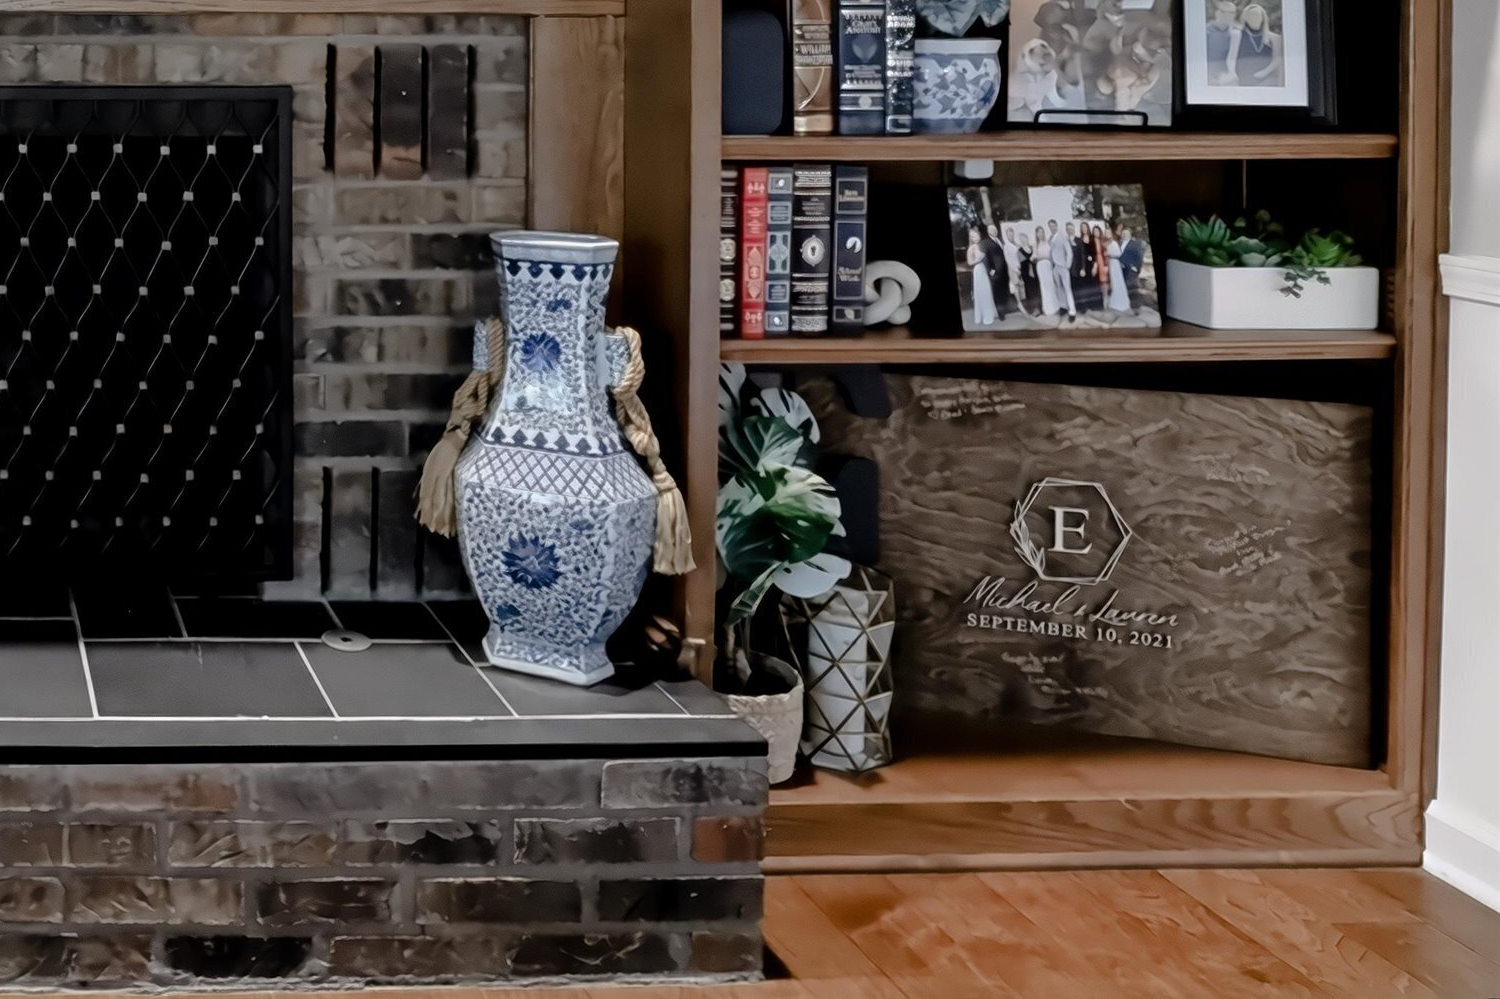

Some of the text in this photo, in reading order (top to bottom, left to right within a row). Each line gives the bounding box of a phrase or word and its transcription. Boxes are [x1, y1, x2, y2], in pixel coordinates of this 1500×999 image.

[1047, 505, 1093, 554] E
[963, 575, 1081, 616] Michael
[1089, 589, 1179, 627] Lauren
[967, 612, 1089, 640] SEPTEMBER
[1128, 630, 1174, 649] 2021
